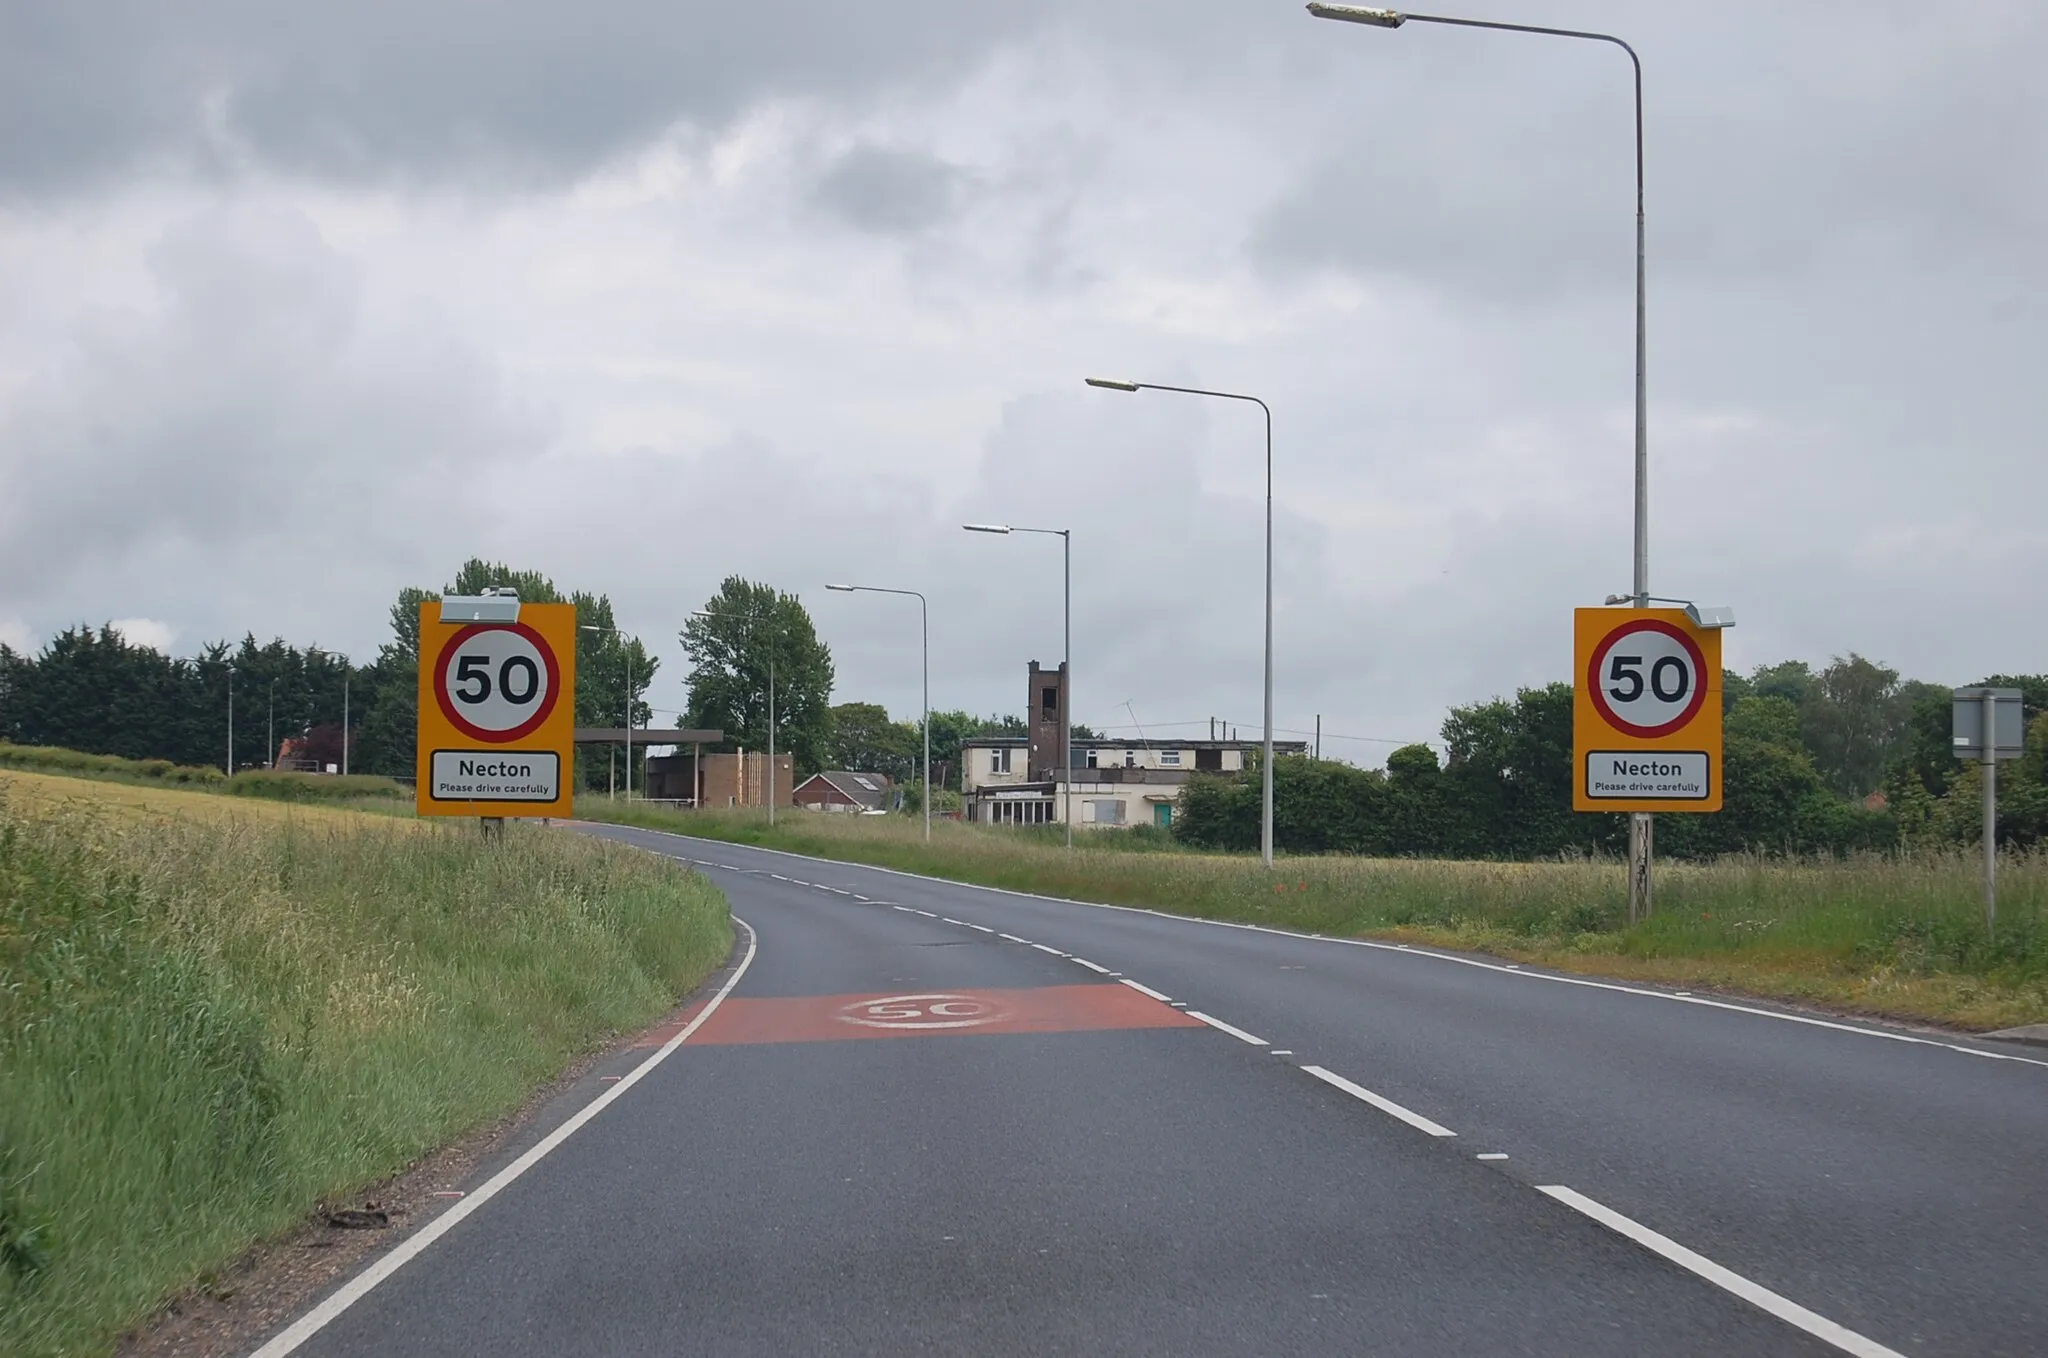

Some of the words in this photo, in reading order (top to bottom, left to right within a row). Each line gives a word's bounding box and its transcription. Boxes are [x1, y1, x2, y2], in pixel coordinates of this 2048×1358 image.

[456, 655, 539, 705] 50
[1609, 655, 1689, 703] 50
[459, 760, 531, 777] Necton
[1613, 760, 1682, 776] Necton
[440, 783, 473, 792] Please
[476, 783, 501, 793] drive
[504, 784, 549, 795] carefully
[1595, 782, 1626, 791] Please
[1629, 782, 1654, 791] drive
[1656, 782, 1700, 793] carefully
[867, 1003, 984, 1019] 50
